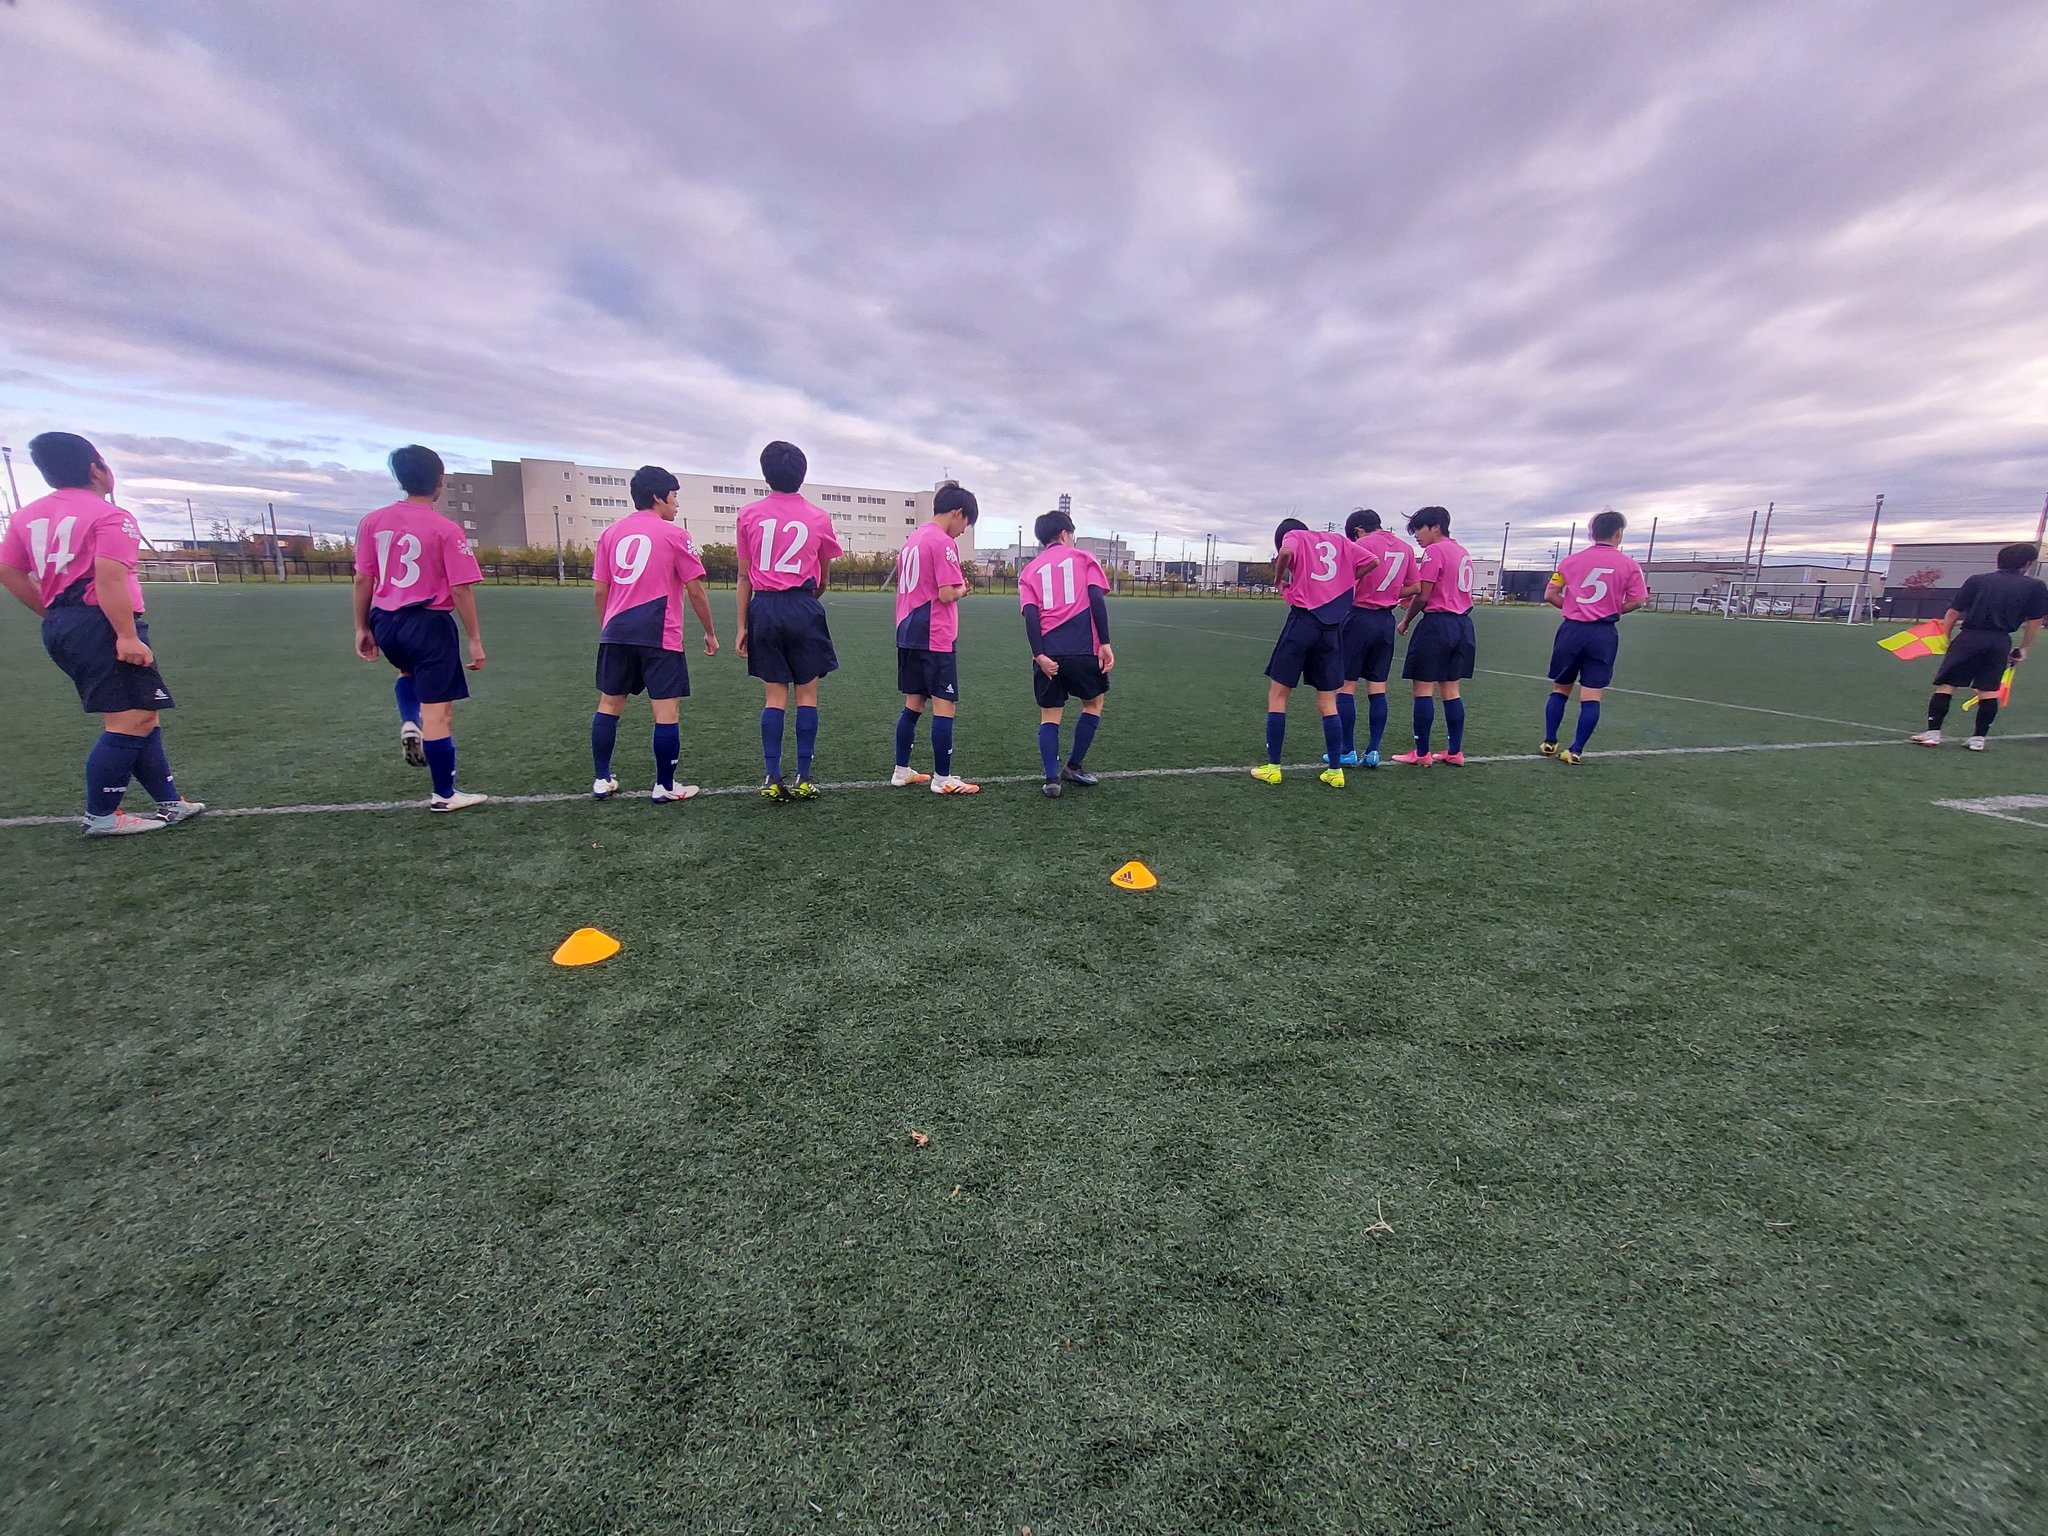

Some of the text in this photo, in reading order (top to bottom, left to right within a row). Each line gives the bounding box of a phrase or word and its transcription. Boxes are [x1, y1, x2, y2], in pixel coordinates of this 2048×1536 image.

[27, 516, 77, 578] 14
[375, 531, 422, 588] 13
[612, 534, 652, 585] 9
[758, 518, 808, 574] 12
[898, 545, 920, 594] 10
[1310, 542, 1338, 582] 3
[1037, 557, 1073, 610] 11
[1376, 551, 1404, 592] 7
[1458, 555, 1474, 593] 6
[1575, 567, 1615, 604] 5
